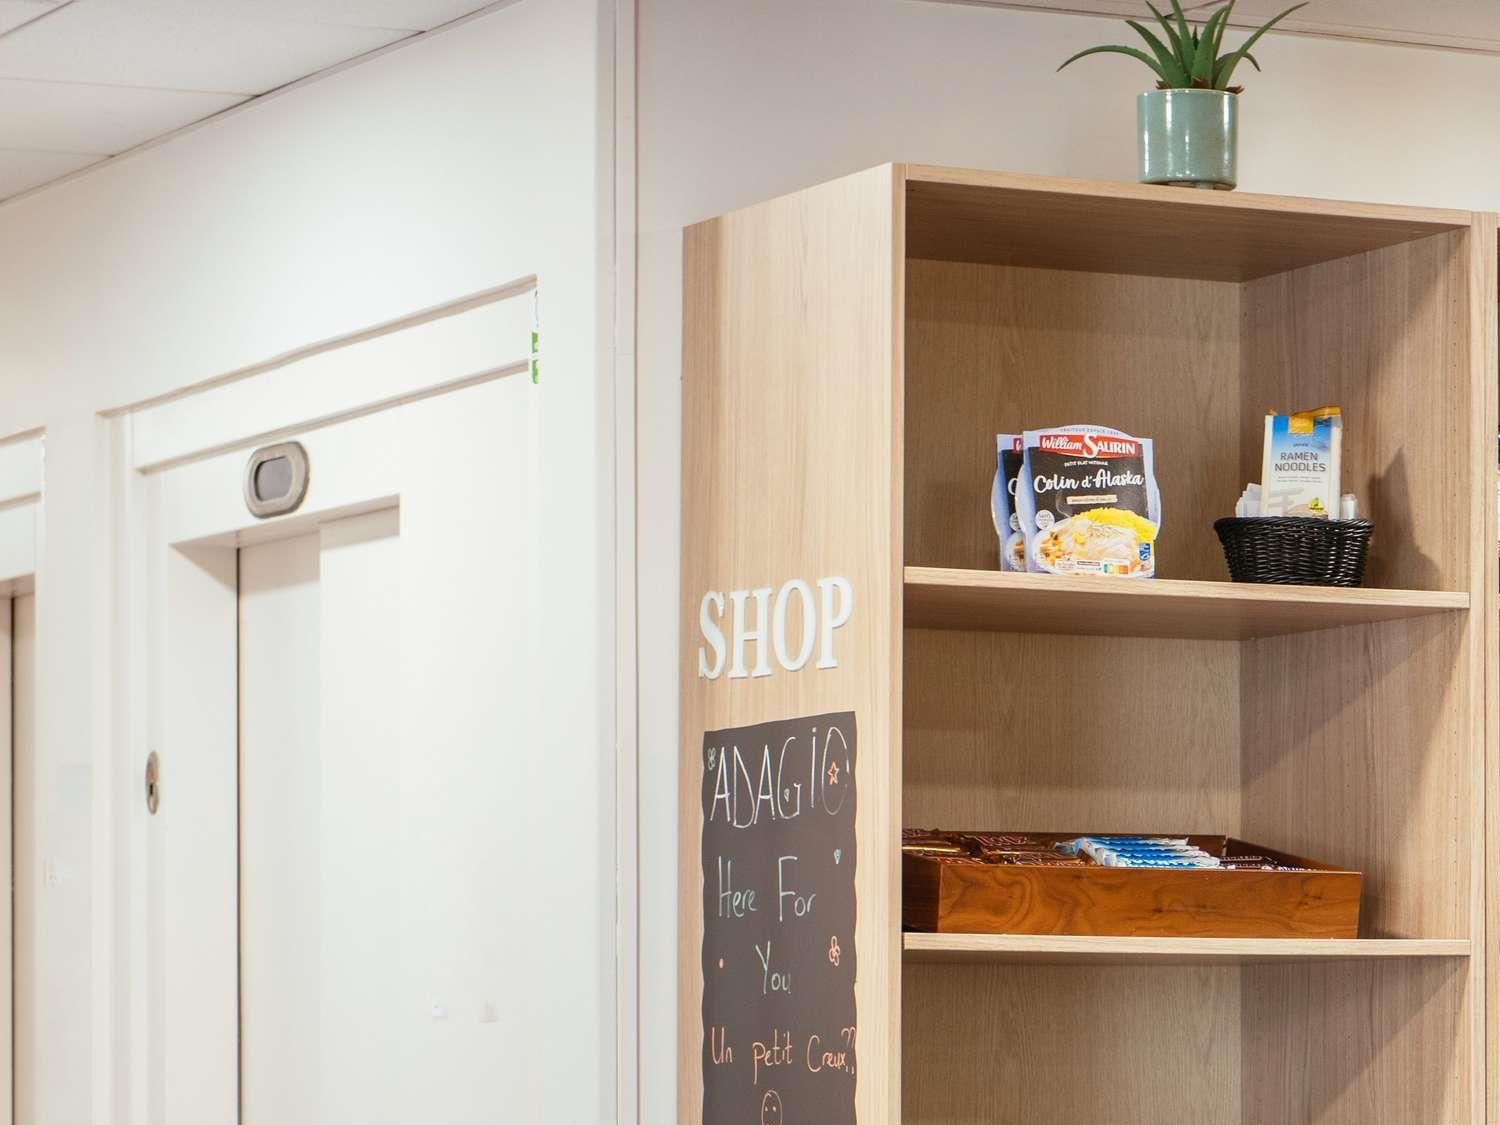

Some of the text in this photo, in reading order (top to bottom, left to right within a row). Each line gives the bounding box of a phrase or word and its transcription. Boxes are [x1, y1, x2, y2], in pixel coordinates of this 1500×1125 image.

[1041, 436, 1082, 450] William
[1280, 451, 1319, 461] RAMEN
[1033, 468, 1144, 493] Colin d'Alaska
[1274, 462, 1327, 472] NOODLES
[698, 576, 854, 680] SHOP
[710, 727, 850, 829] ADAGIO
[717, 855, 816, 922] Here For
[755, 940, 791, 995] You
[711, 1026, 733, 1065] Un
